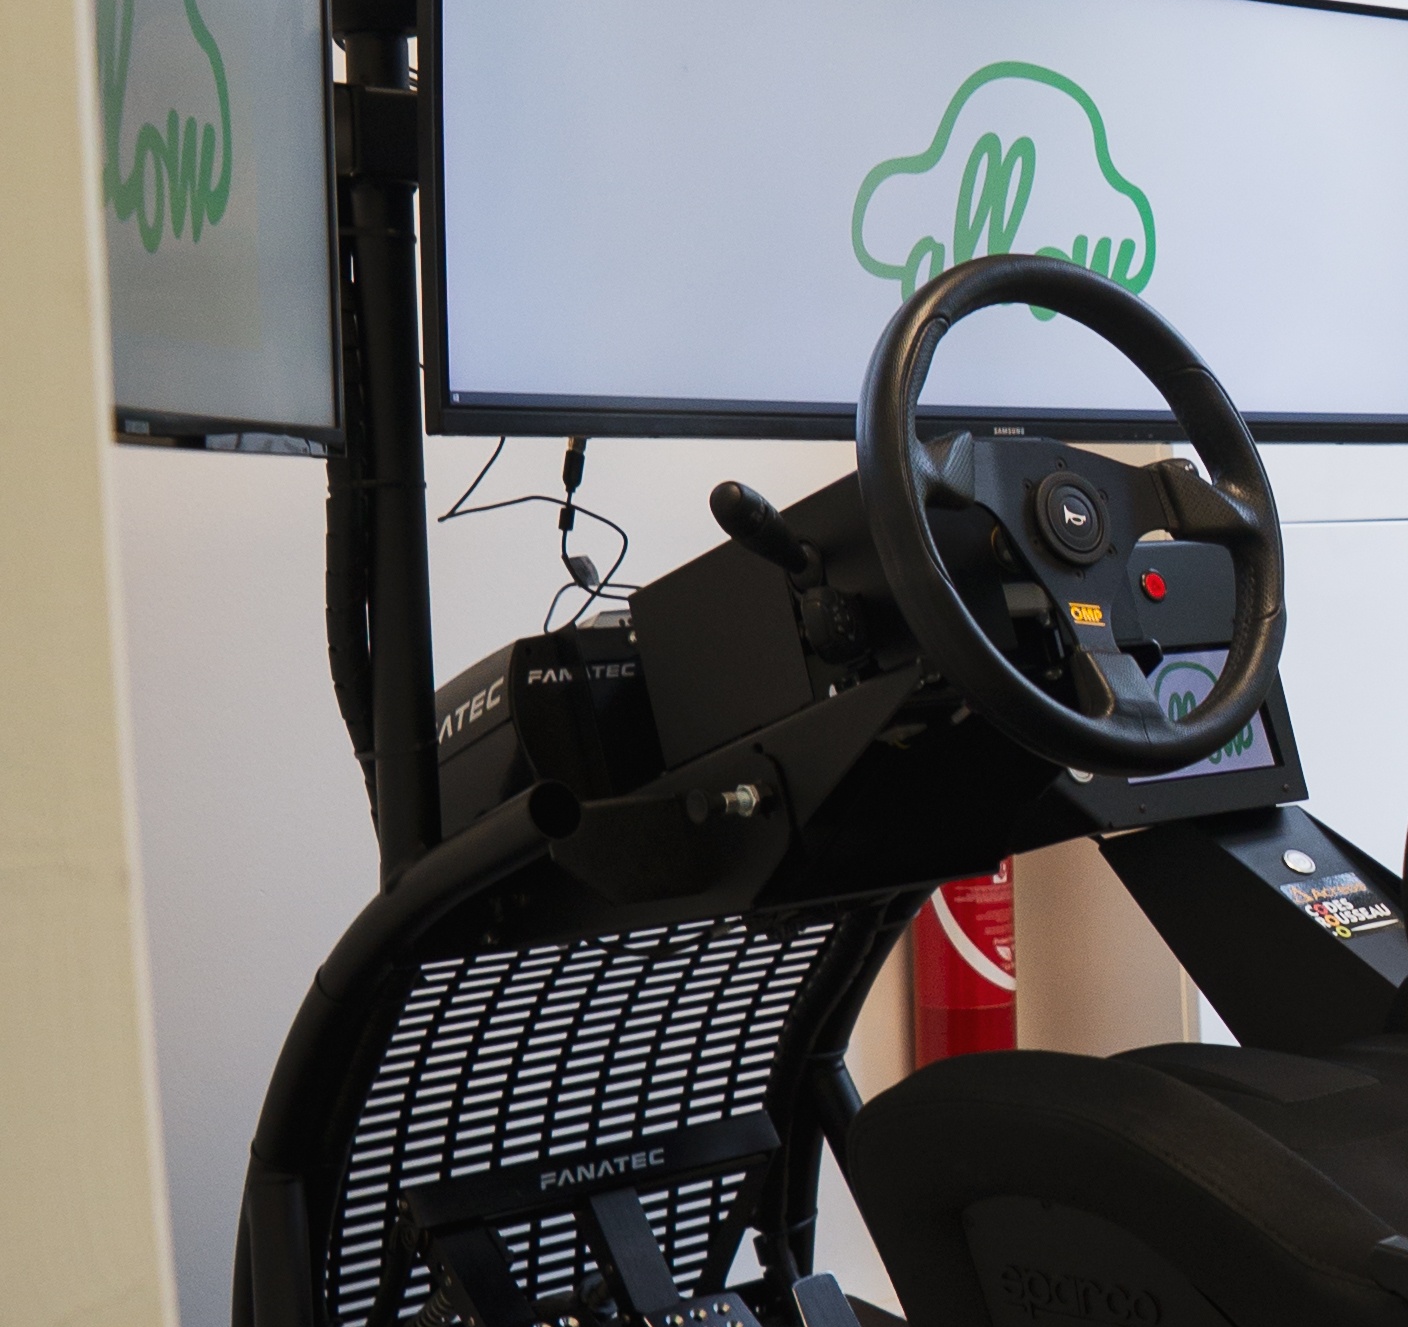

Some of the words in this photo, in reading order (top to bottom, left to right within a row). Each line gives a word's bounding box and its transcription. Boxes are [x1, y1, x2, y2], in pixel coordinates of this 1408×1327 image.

[1070, 605, 1103, 623] OMP
[436, 676, 505, 745] ATEC
[1305, 897, 1354, 917] CODES
[1315, 903, 1392, 928] ROUSSEAU
[540, 1148, 665, 1191] FANATEC
